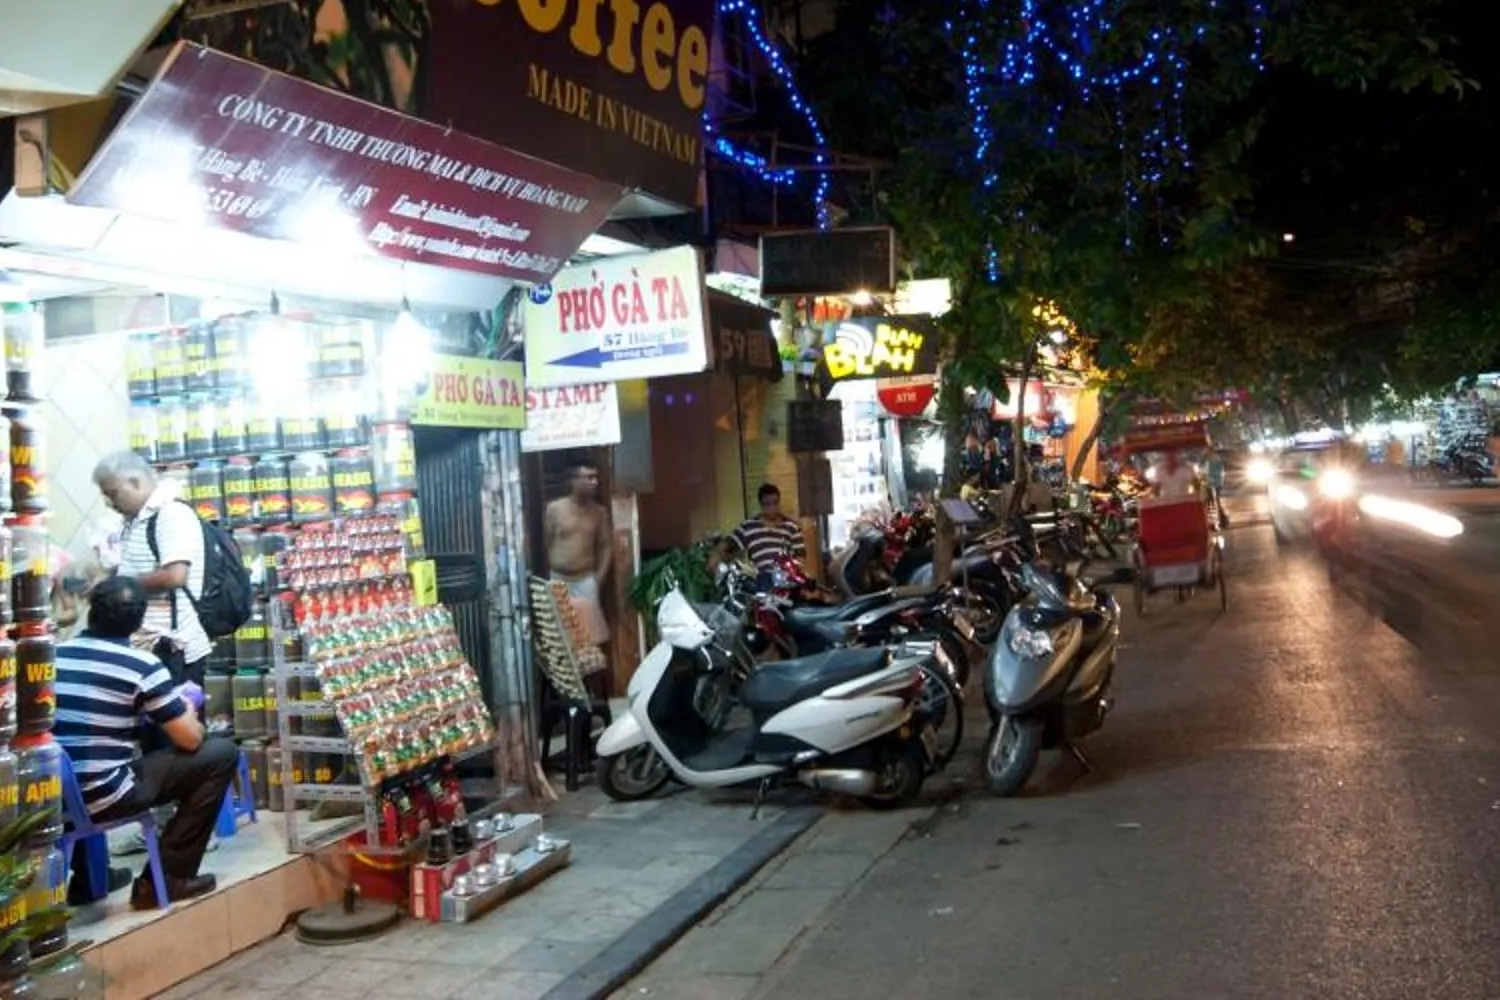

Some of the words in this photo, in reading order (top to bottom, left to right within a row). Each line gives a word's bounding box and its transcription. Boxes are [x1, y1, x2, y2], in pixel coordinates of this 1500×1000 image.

[280, 112, 315, 137] TY
[307, 120, 365, 153] TNHH
[527, 63, 592, 123] MADE
[595, 94, 619, 132] IN
[621, 103, 698, 167] VIETNAM
[611, 267, 649, 326] GÀ
[652, 275, 689, 321] TA
[823, 339, 916, 379] BLAH
[499, 377, 521, 409] TA
[525, 381, 607, 412] STAMP
